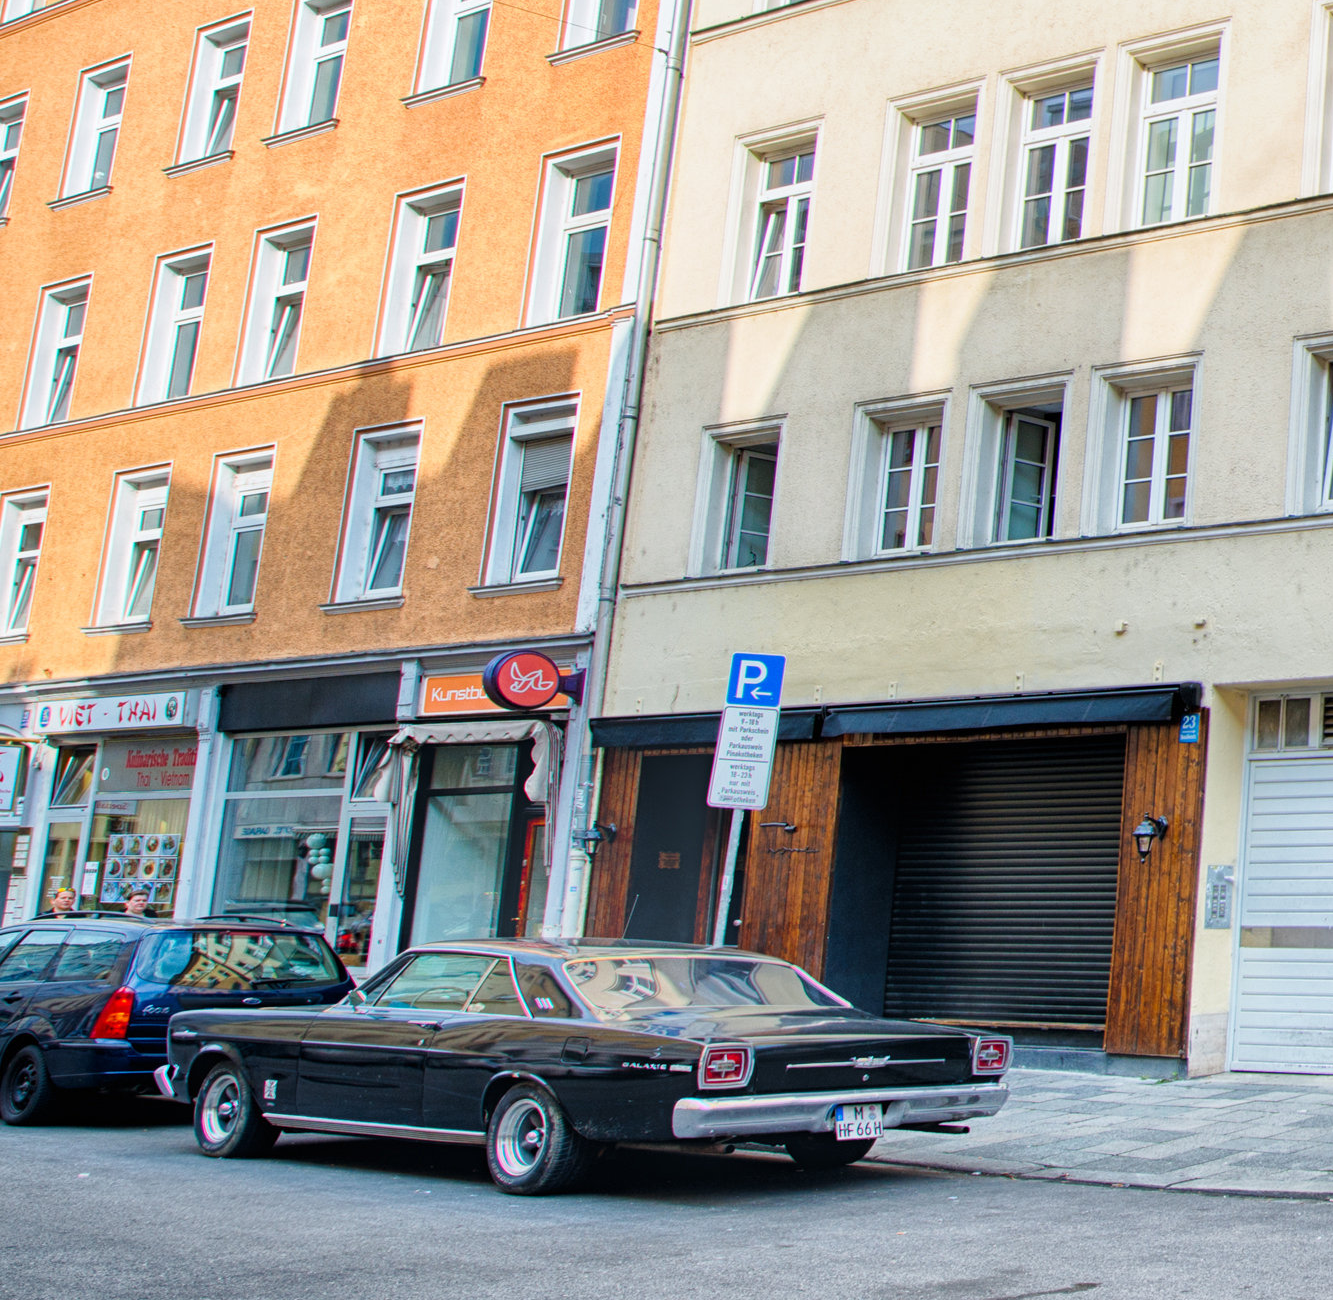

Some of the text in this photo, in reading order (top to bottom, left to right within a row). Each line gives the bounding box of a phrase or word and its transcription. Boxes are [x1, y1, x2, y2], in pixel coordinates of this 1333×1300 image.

[735, 660, 768, 699] P
[59, 703, 97, 727] VIET
[117, 699, 157, 723] THAI
[1183, 715, 1197, 729] 23
[854, 1107, 864, 1121] M
